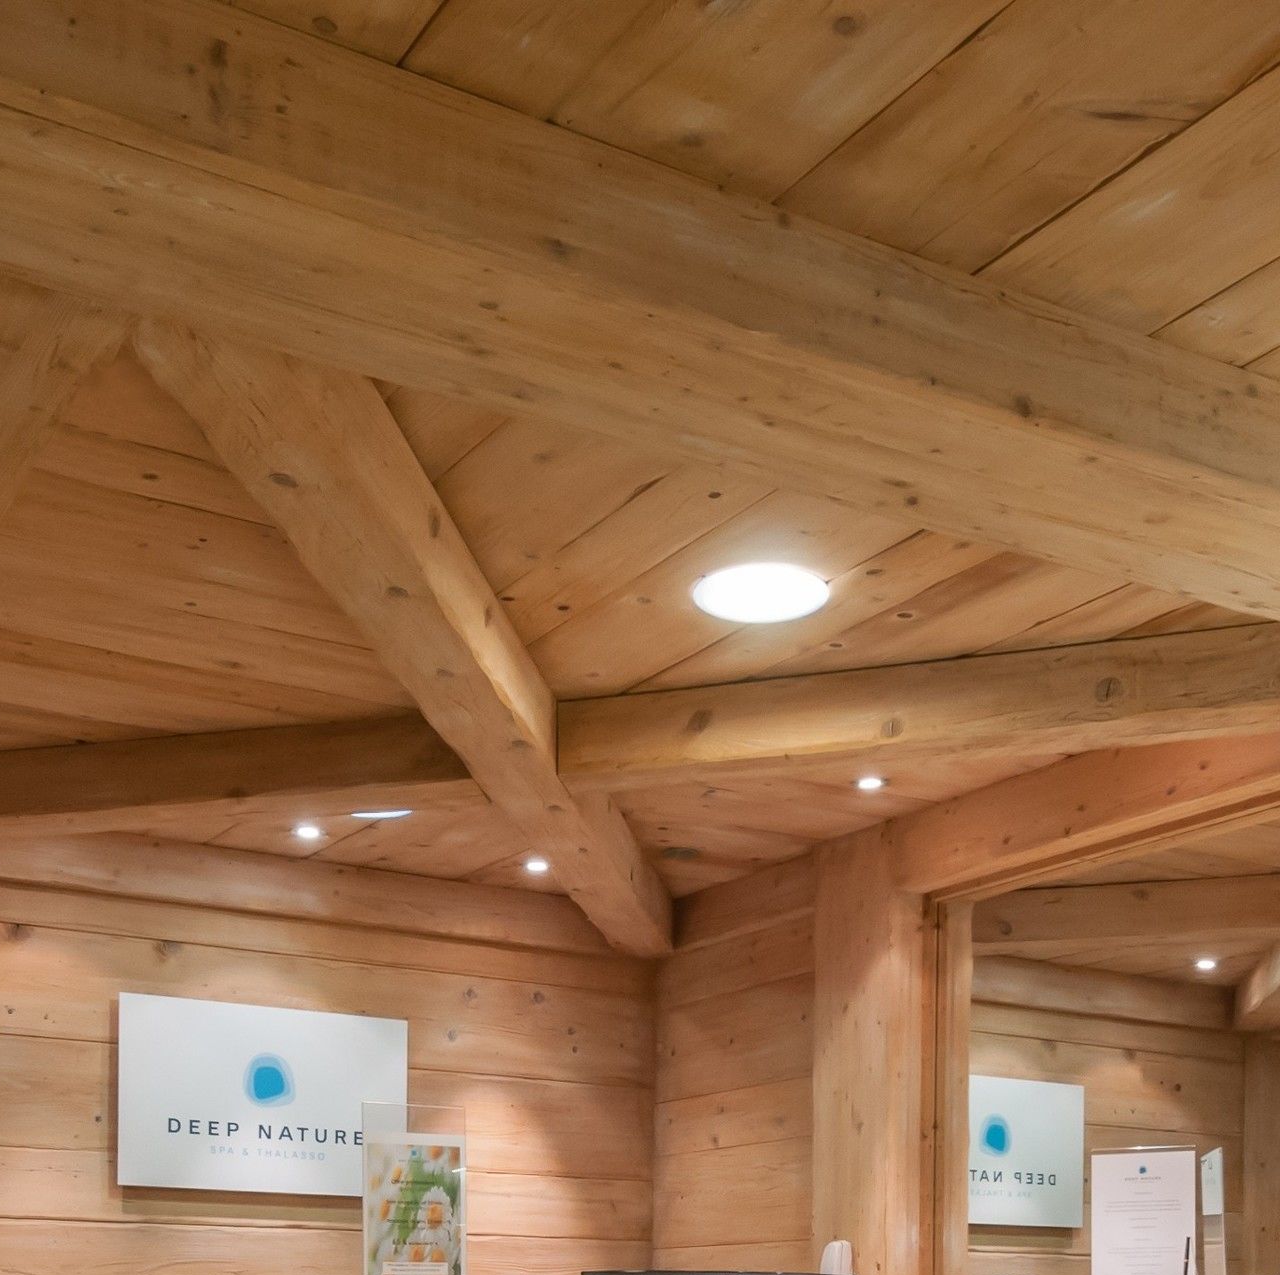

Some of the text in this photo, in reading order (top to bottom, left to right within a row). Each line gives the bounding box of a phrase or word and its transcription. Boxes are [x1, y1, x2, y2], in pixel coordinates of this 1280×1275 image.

[167, 1117, 364, 1146] DEEP NATURE
[210, 1145, 235, 1155] SPA
[257, 1148, 326, 1161] THALASSO
